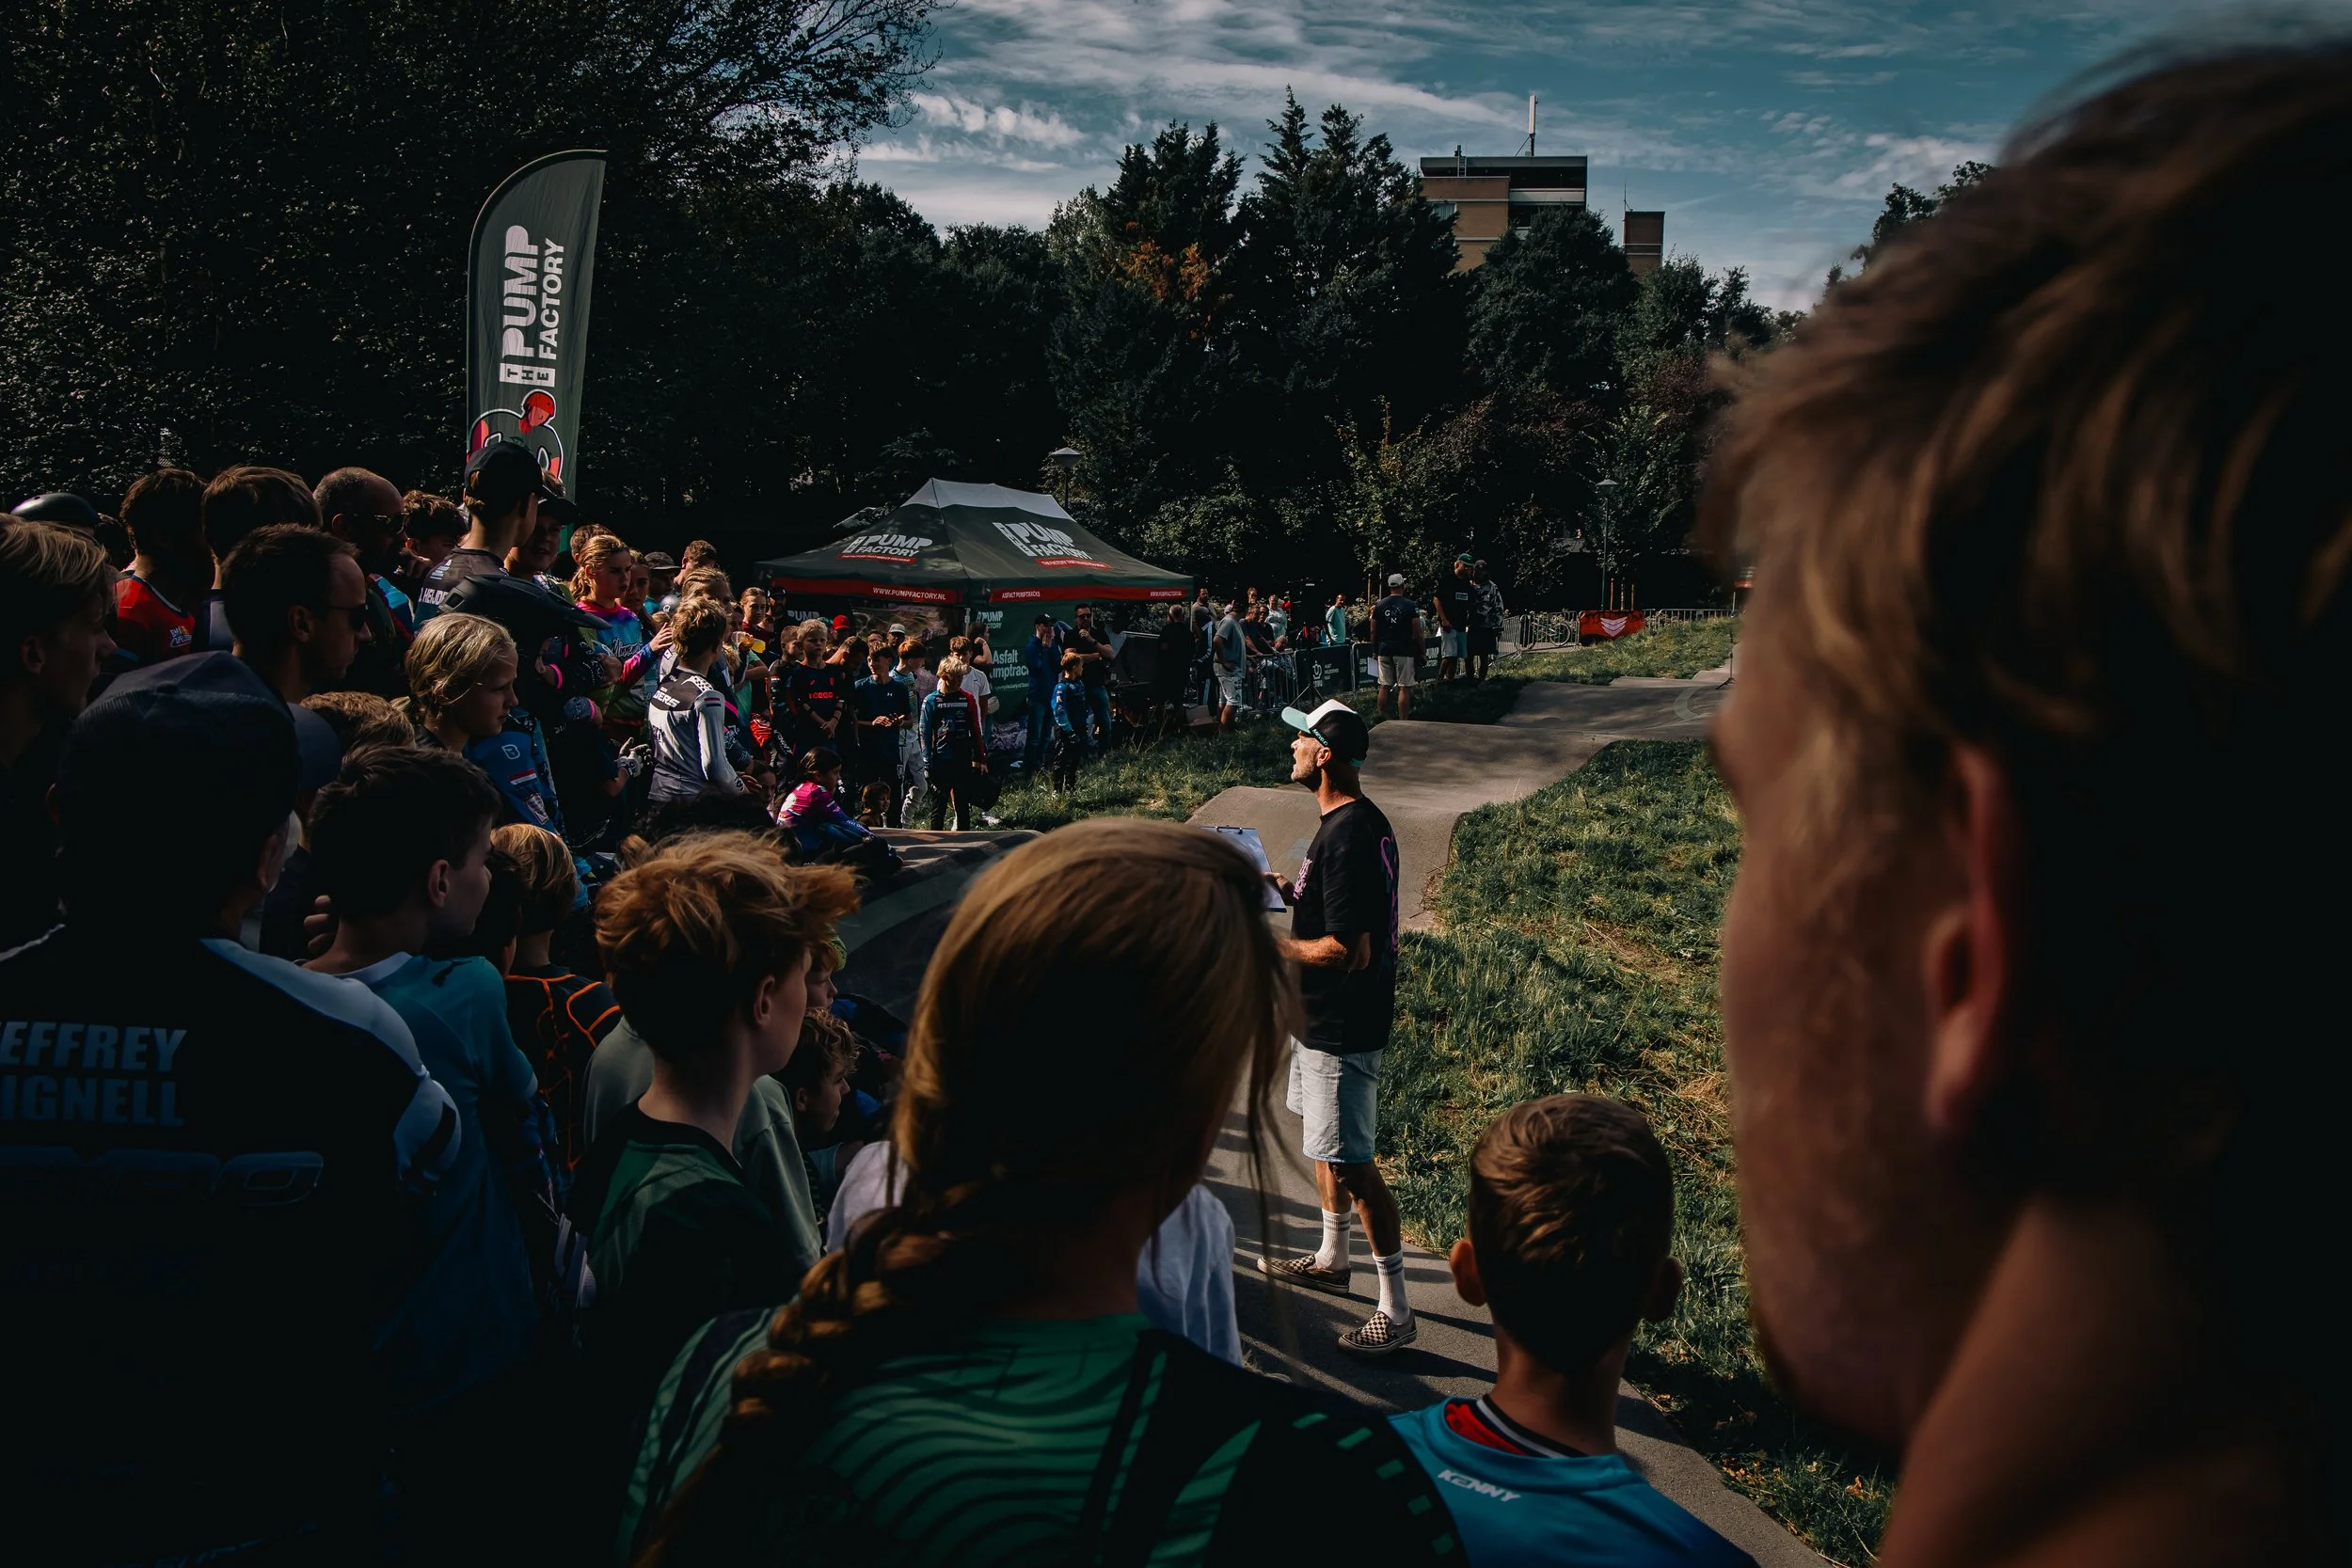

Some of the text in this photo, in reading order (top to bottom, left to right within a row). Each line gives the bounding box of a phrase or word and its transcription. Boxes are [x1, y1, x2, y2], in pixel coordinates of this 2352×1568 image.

[502, 225, 539, 357] PUMP
[538, 237, 564, 360] FACTORY
[503, 365, 552, 384] THE
[863, 533, 932, 549] PUMP
[1005, 522, 1075, 547] PUMP
[855, 546, 919, 557] FACTORY
[1029, 544, 1092, 561] FACTORY
[872, 586, 946, 600] WWW.PUMPFACTORY.NL
[787, 610, 820, 621] PUMP
[981, 610, 1004, 623] PUMP
[993, 649, 1019, 664] Asfalt
[990, 664, 1029, 680] umptrac
[0, 1021, 188, 1073] EFFREY
[1437, 1468, 1522, 1503] KENNY
